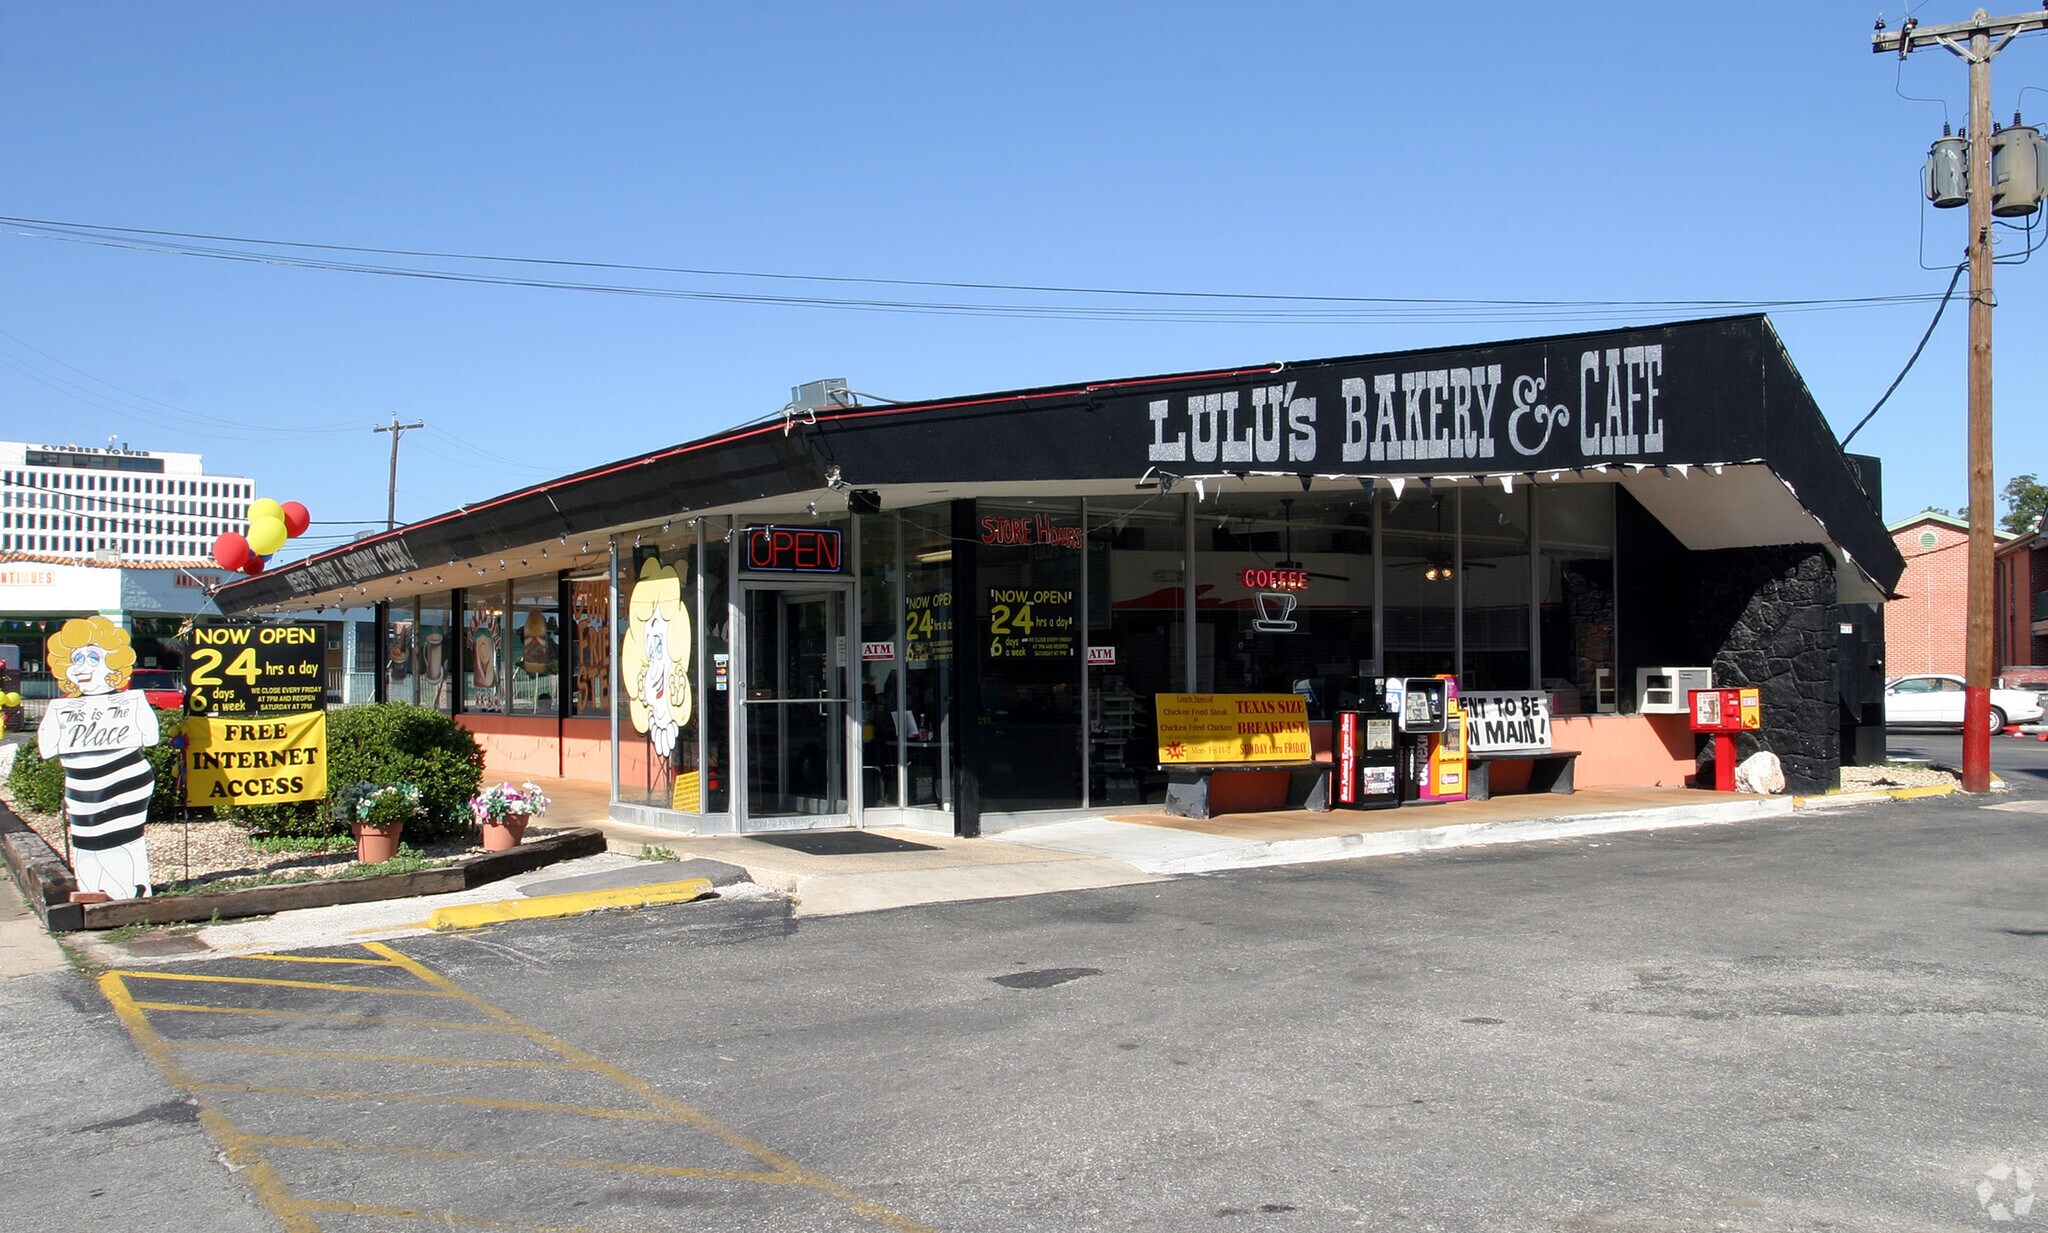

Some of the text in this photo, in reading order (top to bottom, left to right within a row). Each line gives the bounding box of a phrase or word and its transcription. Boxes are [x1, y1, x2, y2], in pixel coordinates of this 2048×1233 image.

[1341, 364, 1502, 462] BAKERY
[1508, 374, 1570, 456] &
[1580, 344, 1664, 456] CAFE
[42, 444, 151, 457] CYPRESS TOWER
[981, 512, 1083, 549] STORE HOURS
[751, 530, 838, 568] OPEN
[1245, 569, 1308, 590] COFFEE
[908, 596, 930, 610] NOW
[995, 590, 1068, 604] NOW OPEN
[906, 608, 933, 641] 24
[991, 605, 1034, 635] 24
[1036, 616, 1047, 627] hrs
[1056, 616, 1069, 630] day
[195, 627, 316, 645] NOW OPEN
[864, 644, 891, 654] ATM
[906, 642, 914, 661] 6
[992, 637, 1019, 656] 6 days
[1011, 648, 1026, 656] week
[1089, 648, 1113, 658] ATM
[190, 647, 318, 686] 24 hrs a day
[292, 694, 316, 702] REOPEN
[301, 685, 322, 693] FRIDAY
[189, 687, 235, 712] 6 days
[212, 699, 246, 712] a week
[260, 703, 291, 711] SATURDAY
[1236, 700, 1305, 714] TEXAS SIZE
[1457, 696, 1540, 719] ENT TO BE
[60, 706, 130, 722] This is The
[1163, 708, 1227, 716] Chicken Fried Steak
[68, 721, 130, 747] Place
[224, 723, 288, 741] FREE
[1160, 724, 1187, 732] Chicken
[1238, 720, 1306, 734] BREAKFAST
[1467, 718, 1546, 746] N MAIN!
[1240, 743, 1267, 755] SUNDAY
[1284, 742, 1307, 753] FRIDAY
[192, 747, 318, 770] INTERNET
[1416, 734, 1429, 787] conexi
[209, 776, 304, 798] ACCESS
